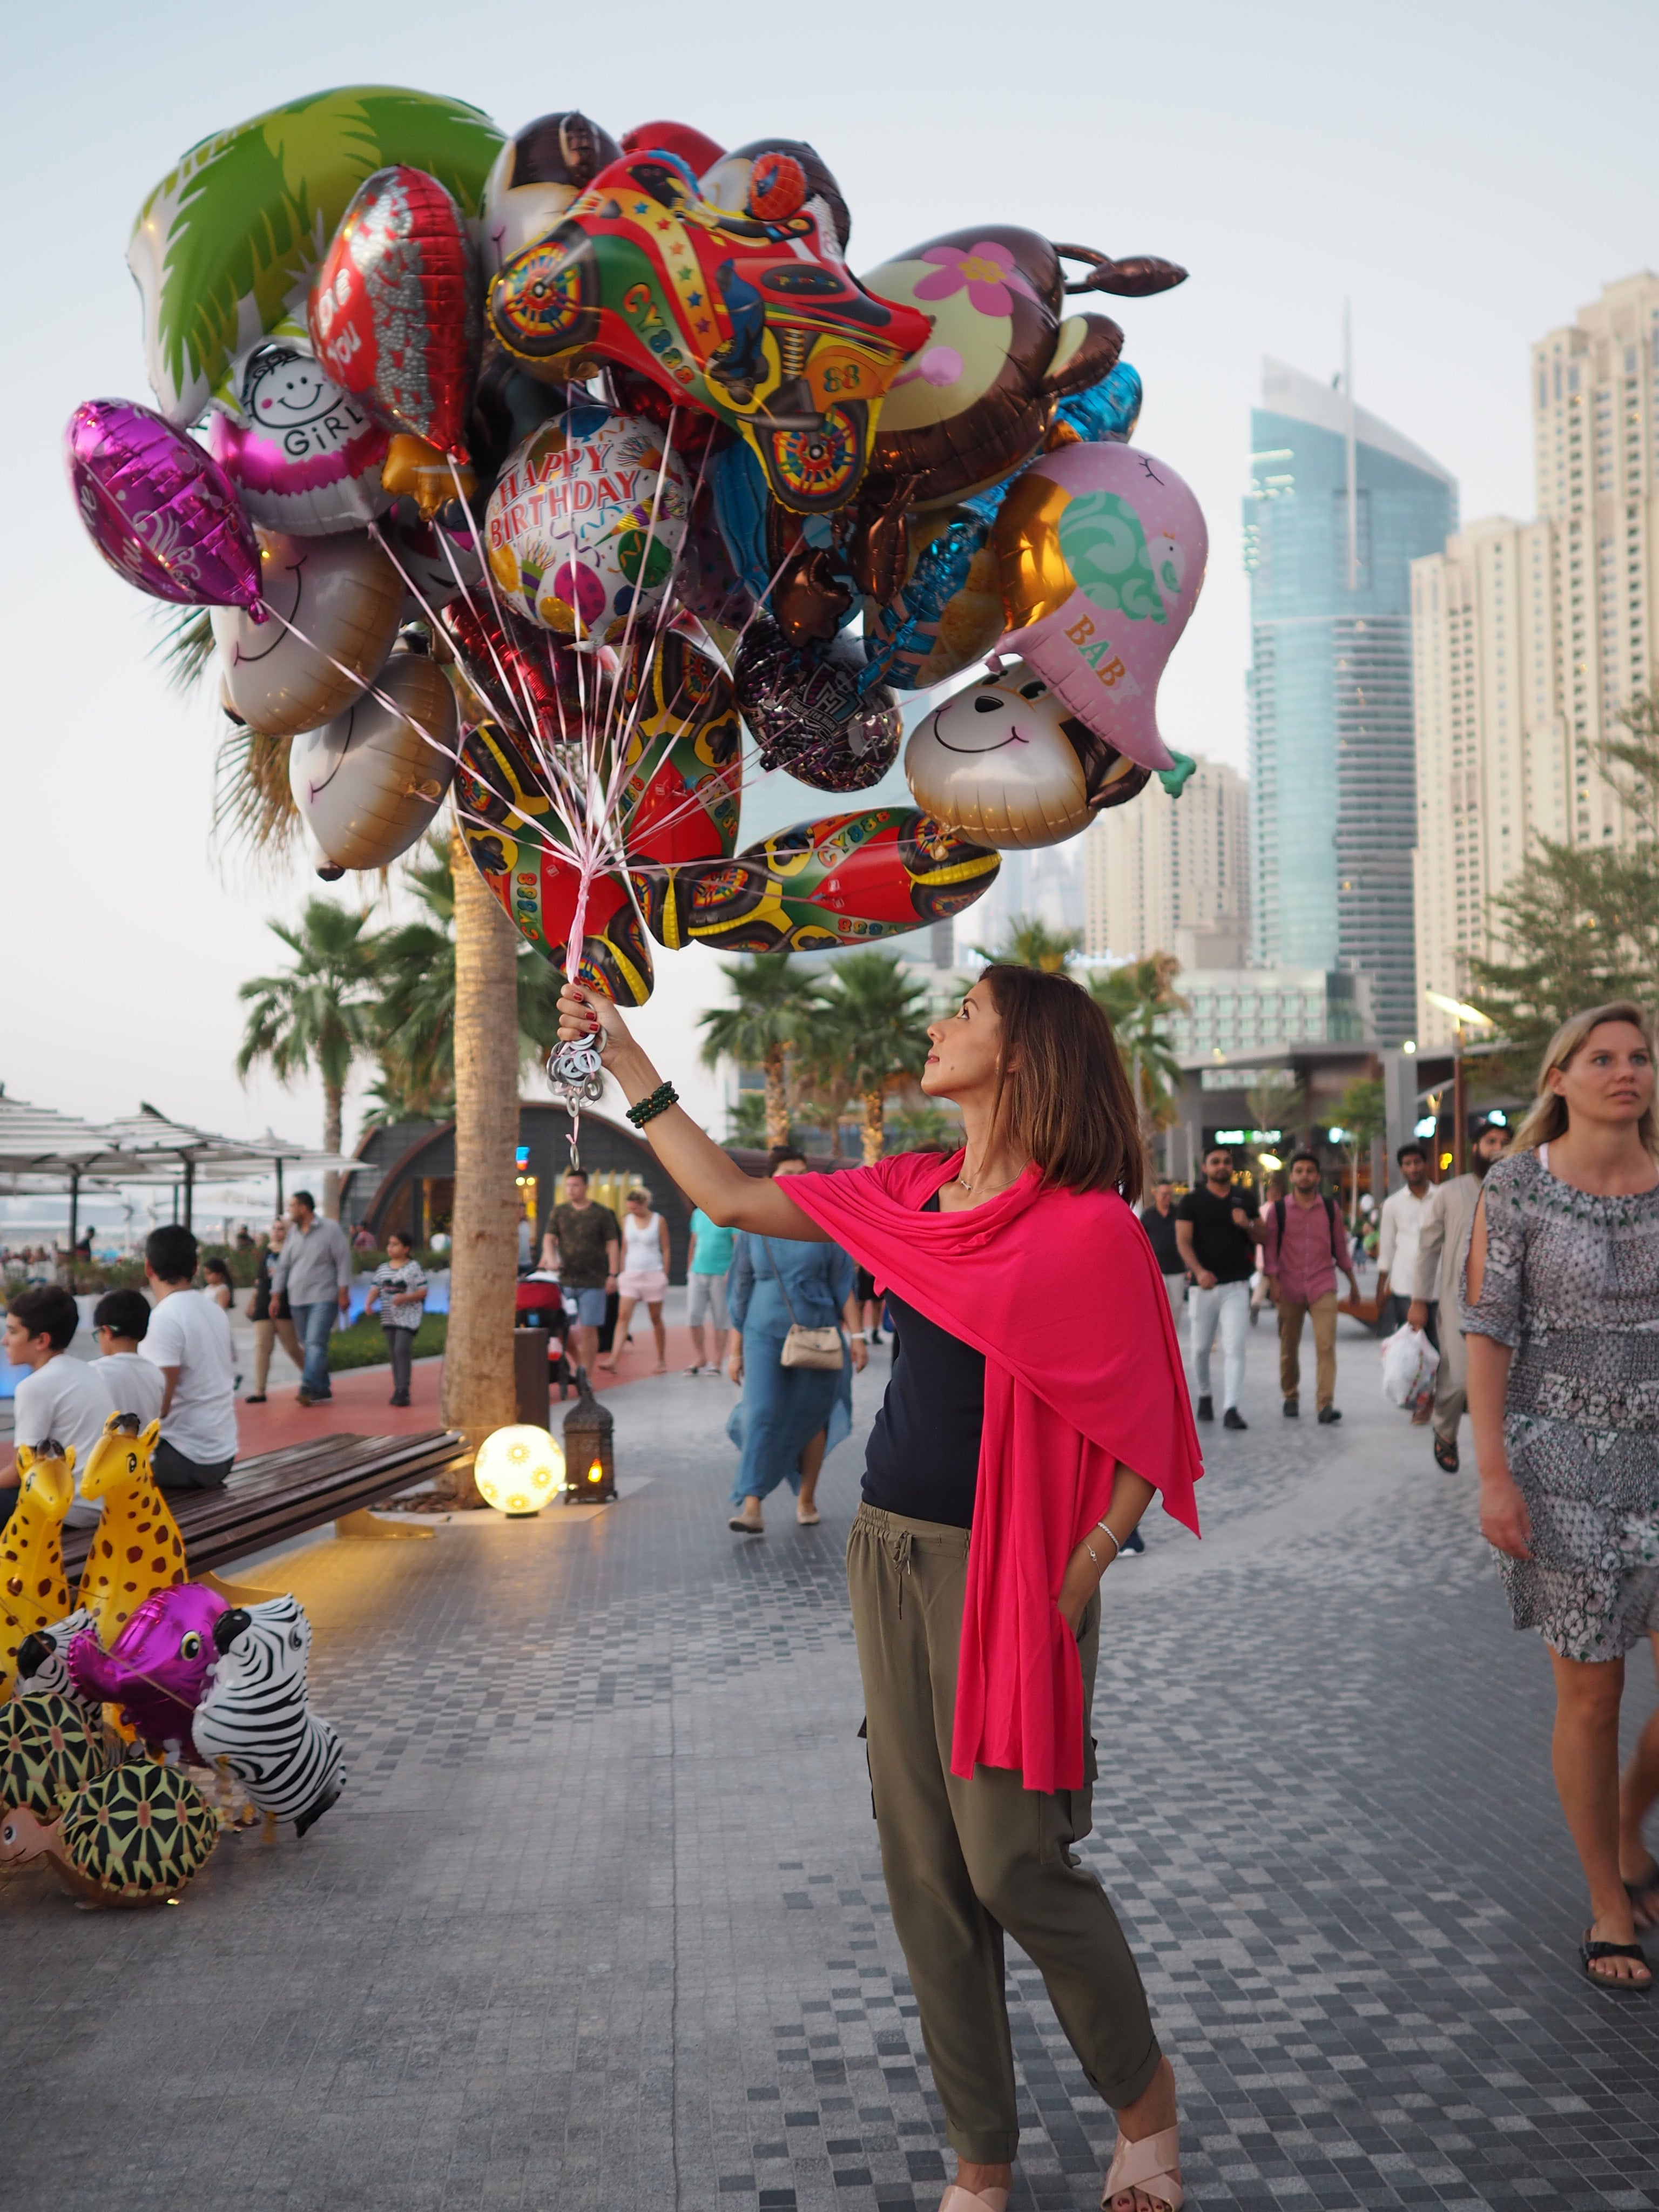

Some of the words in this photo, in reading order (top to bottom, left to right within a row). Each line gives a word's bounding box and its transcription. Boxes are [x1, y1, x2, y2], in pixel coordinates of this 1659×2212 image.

[623, 281, 694, 384] CY888
[824, 364, 860, 393] 88
[489, 469, 640, 550] BIRTHDAY
[497, 443, 613, 513] HAPPY
[818, 811, 891, 868] CY888
[517, 872, 539, 941] CY888
